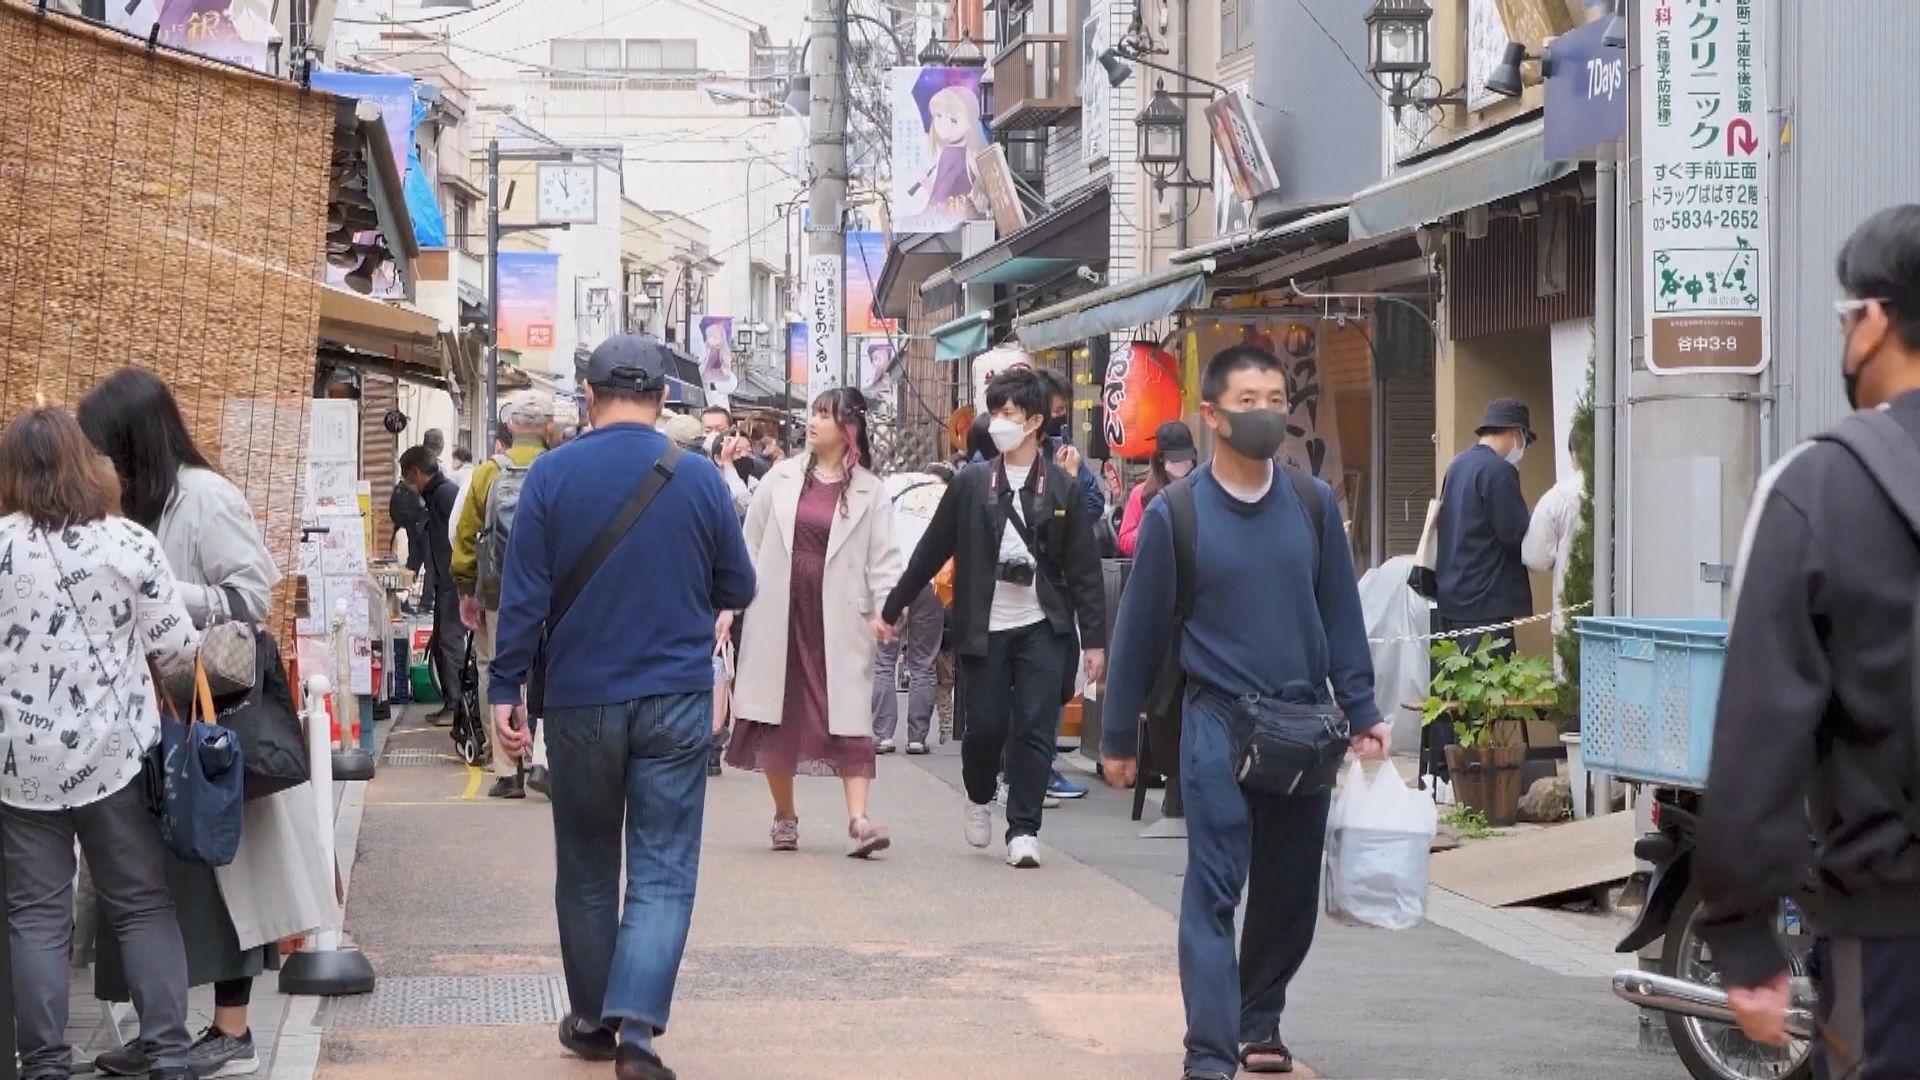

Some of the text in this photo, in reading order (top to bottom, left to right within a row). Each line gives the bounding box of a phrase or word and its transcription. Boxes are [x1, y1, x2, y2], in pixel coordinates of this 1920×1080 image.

[1587, 58, 1622, 101] 7Days
[1654, 161, 1758, 181] すぐ手前正面
[1652, 209, 1759, 231] 03-5834-2652
[1677, 335, 1738, 352] 谷中3-8
[1103, 350, 1135, 448] おでん
[54, 567, 93, 593] KARL
[147, 613, 181, 643] KARL
[17, 708, 55, 732] KARL
[58, 763, 98, 795] KARL
